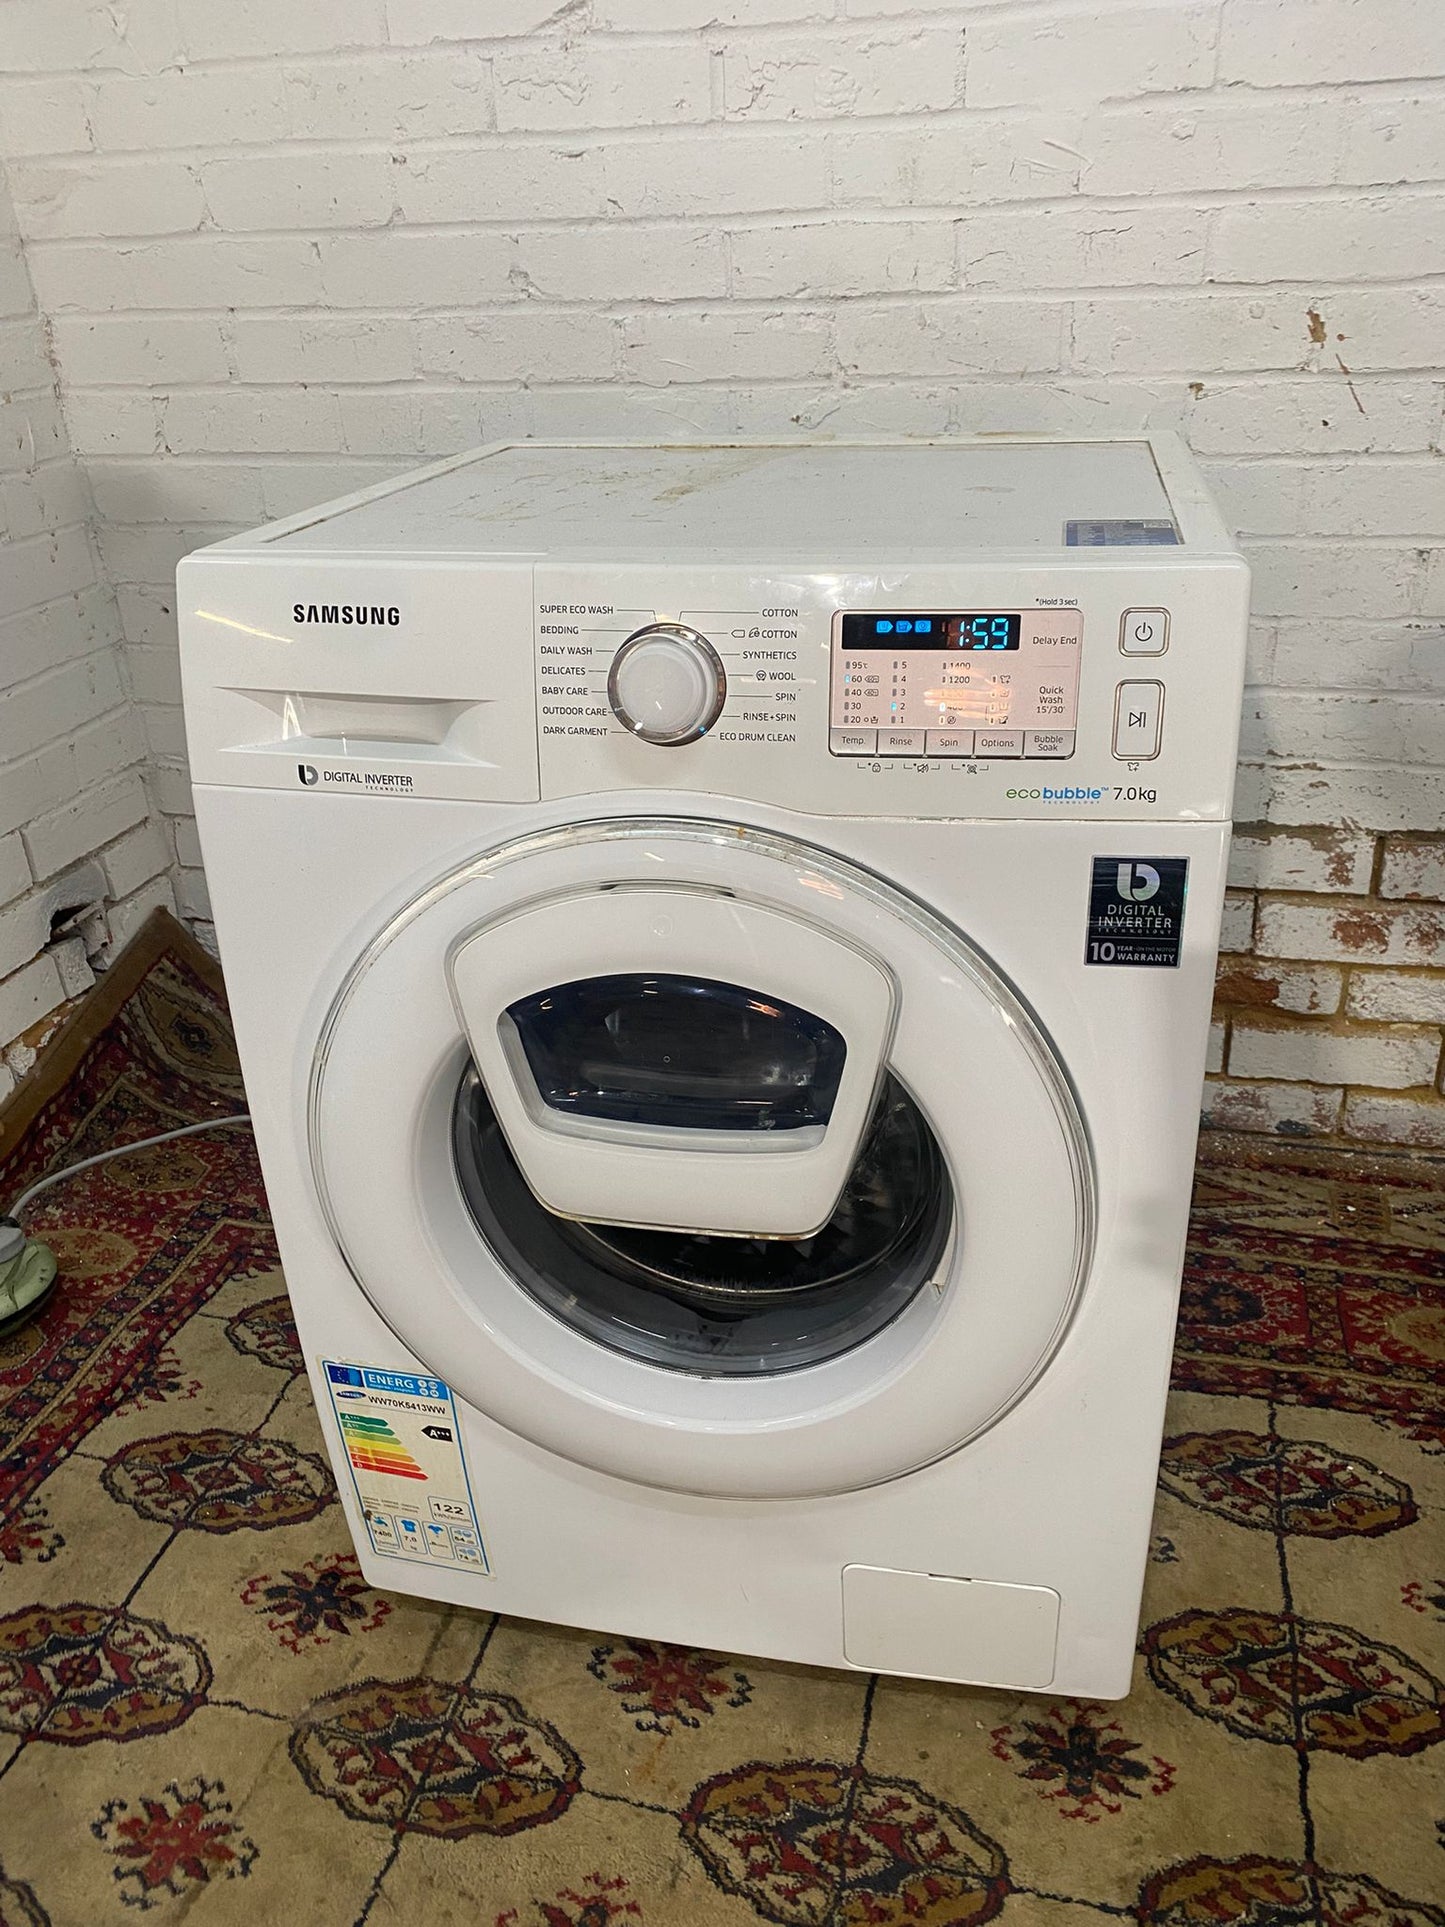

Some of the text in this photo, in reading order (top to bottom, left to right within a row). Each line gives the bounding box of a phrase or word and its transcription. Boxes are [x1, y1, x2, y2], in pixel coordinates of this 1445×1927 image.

[539, 604, 614, 614] SUPER ECO WASH
[762, 608, 798, 617] COTTON
[293, 604, 400, 626] SAMSUNG
[540, 625, 579, 635] BEDDING
[761, 629, 798, 639] COTTON
[958, 617, 1010, 650] 1:59
[1032, 636, 1077, 646] Delay End
[540, 645, 593, 655] DAILY WASH
[742, 650, 797, 660] SYNTHETICS
[901, 661, 907, 669] 5
[541, 666, 586, 676] DELICATES
[768, 671, 797, 681] WOOL
[851, 675, 863, 683] 60
[900, 675, 907, 683] 4
[949, 676, 970, 684] 1200
[541, 686, 589, 696] BABY CARE
[851, 688, 862, 697] 40
[900, 689, 906, 697] 3
[1039, 686, 1064, 695] Quick
[775, 692, 797, 702] SPIN
[1039, 696, 1063, 704] Wash
[542, 706, 608, 716] OUTDOOR CARE
[850, 702, 862, 710] 30
[899, 702, 906, 710] 2
[850, 715, 861, 724] 20
[900, 716, 905, 724] 1
[543, 725, 608, 736] DARK GARMENT
[719, 731, 796, 742] ECO DRUM CLEAN
[841, 736, 866, 746] Temp.
[889, 737, 913, 746] Rinse
[1034, 735, 1064, 744] Bubble
[939, 738, 959, 748] Spin
[981, 738, 1015, 748] Options
[1037, 743, 1059, 752] Soak
[323, 770, 413, 787] DIGITAL INVERTER
[1107, 904, 1165, 916] DIGITAL
[1098, 916, 1173, 929] INVERTER
[1090, 942, 1116, 962] 10
[1116, 952, 1175, 963] WARRANTY
[367, 1373, 414, 1390] ENERG
[368, 1395, 446, 1415] WW70K5413WW
[433, 1502, 465, 1516] 122
